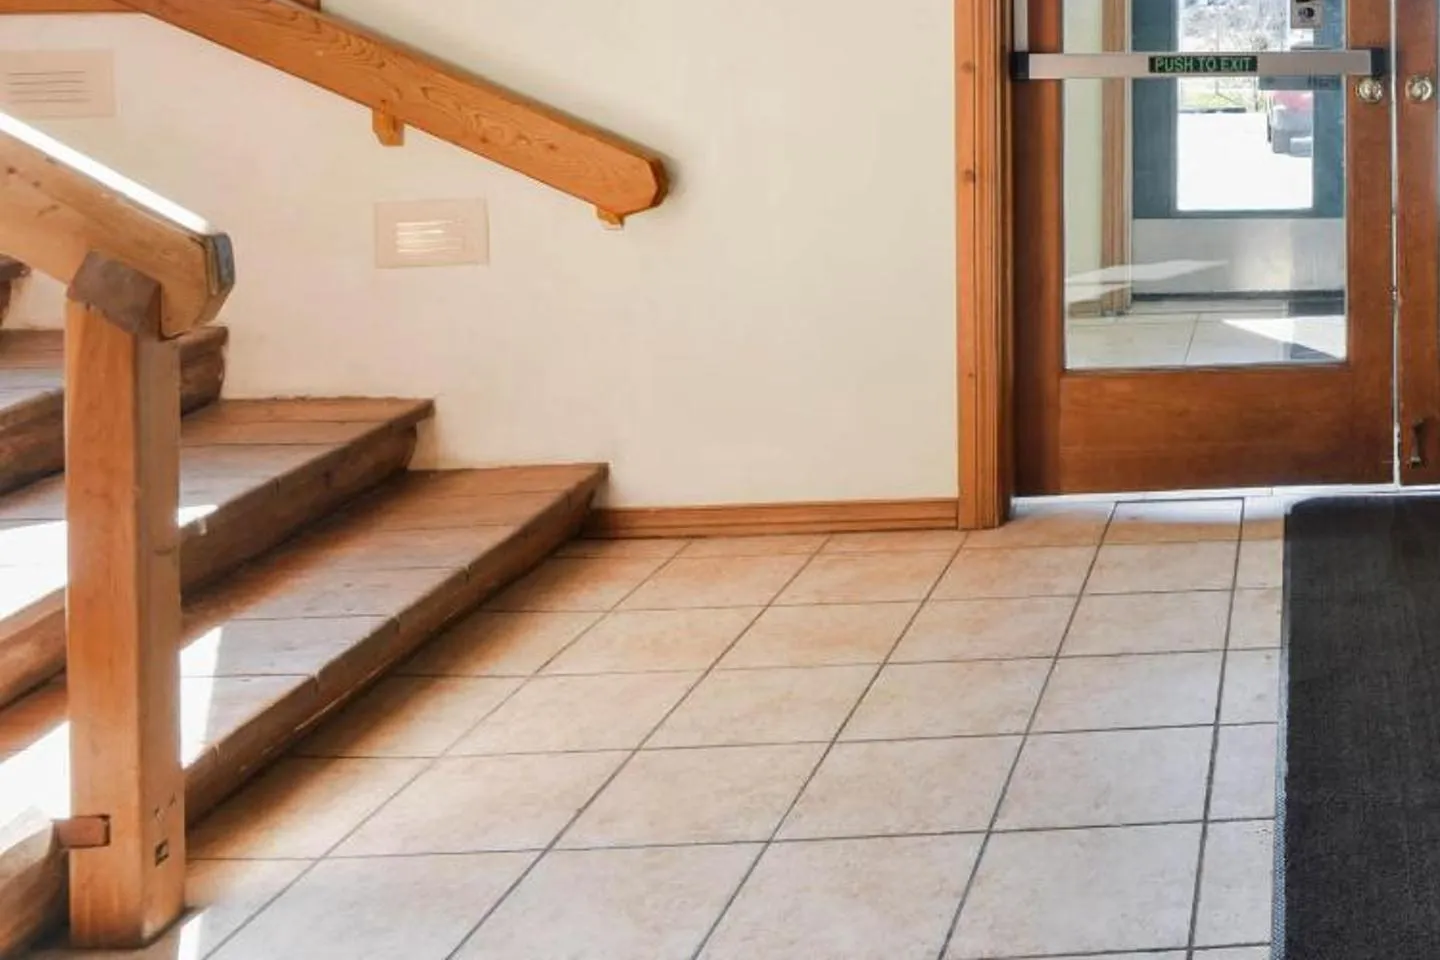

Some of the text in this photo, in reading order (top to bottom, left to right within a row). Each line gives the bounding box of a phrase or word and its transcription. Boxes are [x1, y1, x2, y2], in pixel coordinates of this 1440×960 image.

[1156, 56, 1252, 71] PUSH TO EXIT
